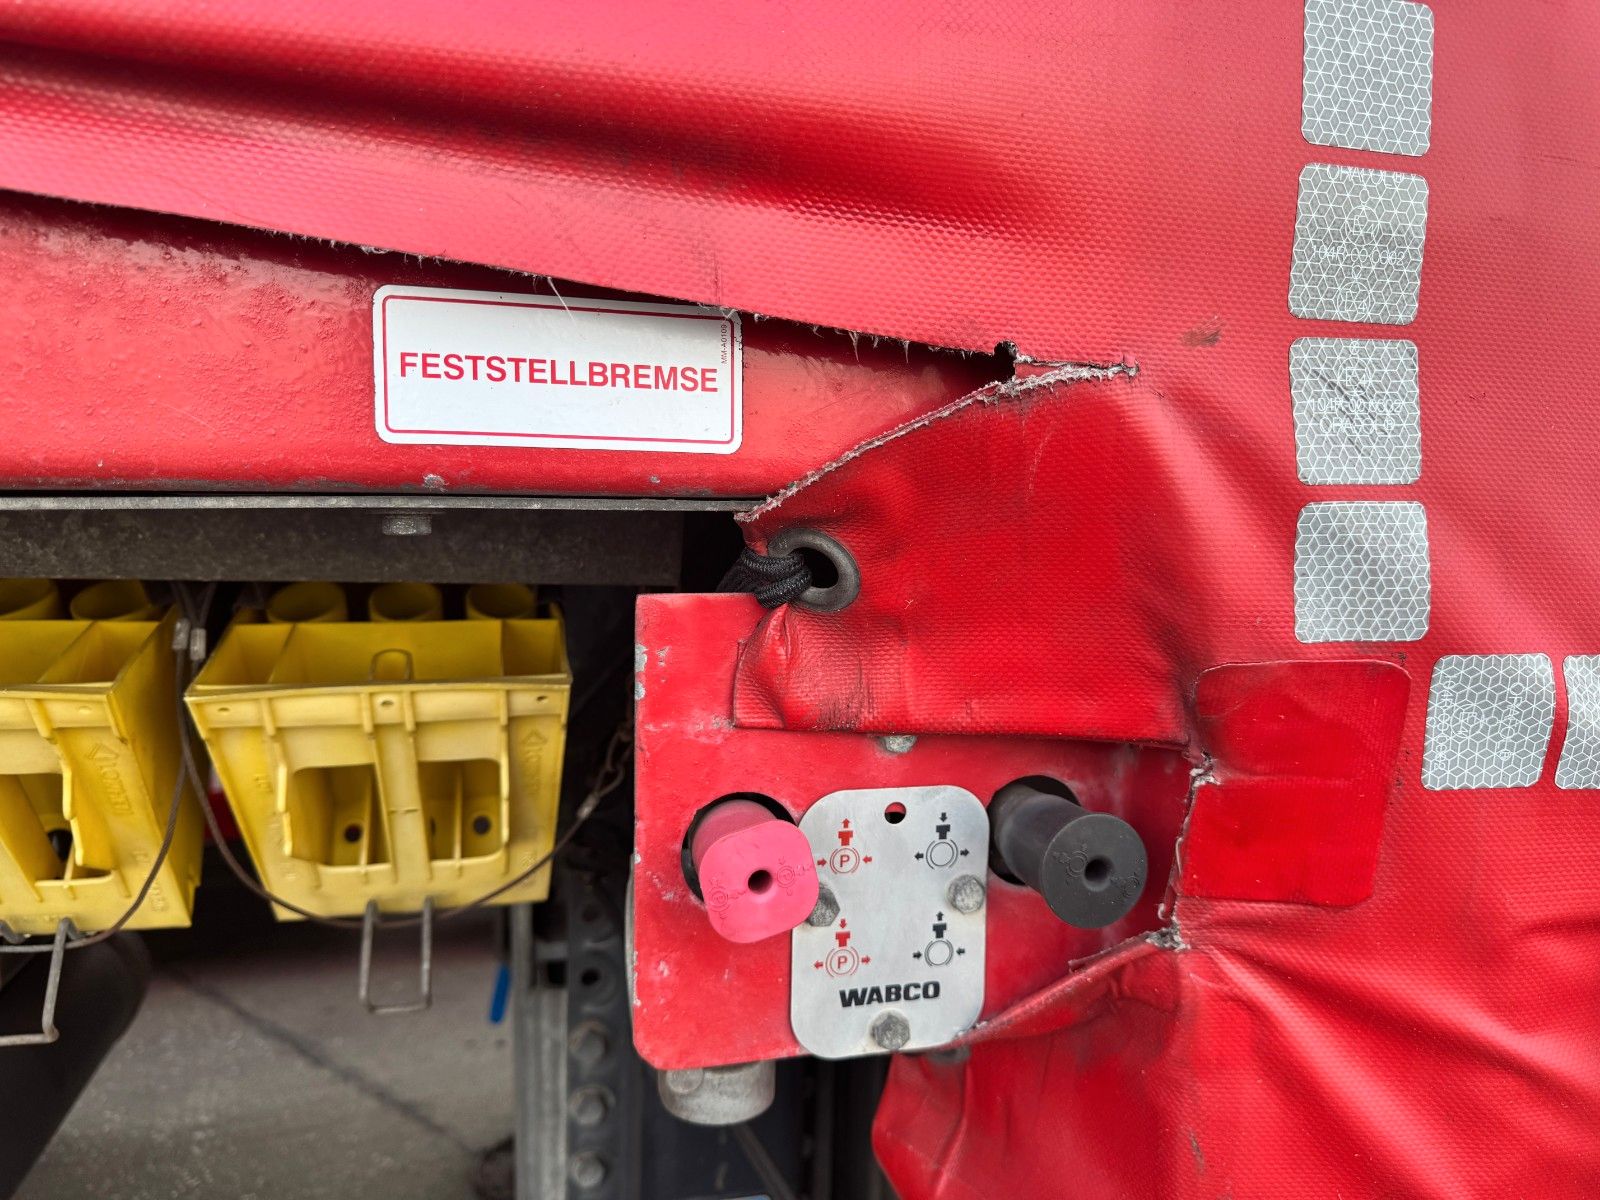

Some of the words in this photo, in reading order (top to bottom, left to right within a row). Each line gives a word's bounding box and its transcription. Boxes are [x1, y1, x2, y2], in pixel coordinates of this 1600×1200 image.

[400, 351, 718, 393] FESTSTELLBREMSE
[839, 853, 850, 868] P
[838, 955, 848, 969] P
[839, 980, 940, 1008] WABCO
